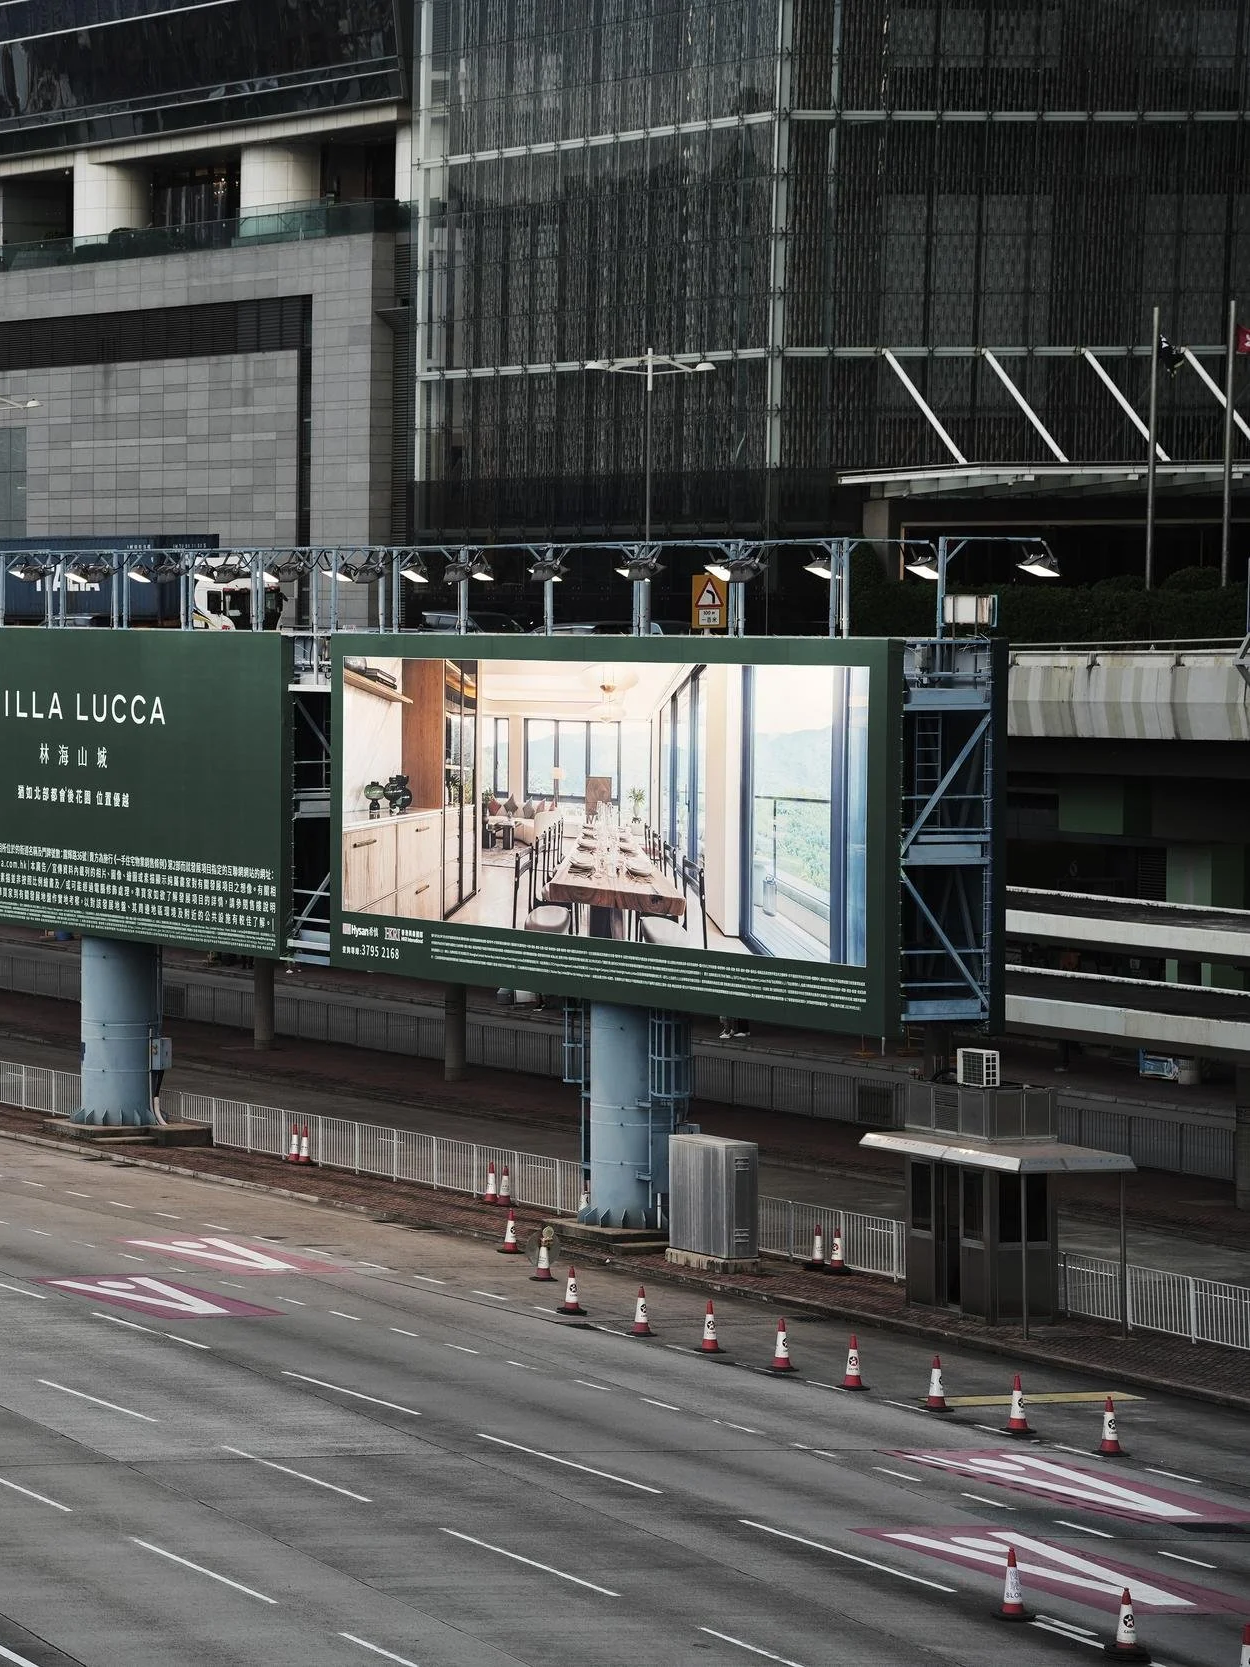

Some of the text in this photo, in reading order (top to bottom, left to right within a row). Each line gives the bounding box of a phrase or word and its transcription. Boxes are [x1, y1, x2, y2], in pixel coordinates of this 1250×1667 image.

[76, 693, 166, 725] LUCCA
[39, 742, 108, 769] 林海山城
[351, 924, 370, 937] Hysan
[361, 944, 379, 957] 3795
[381, 947, 399, 960] 2168
